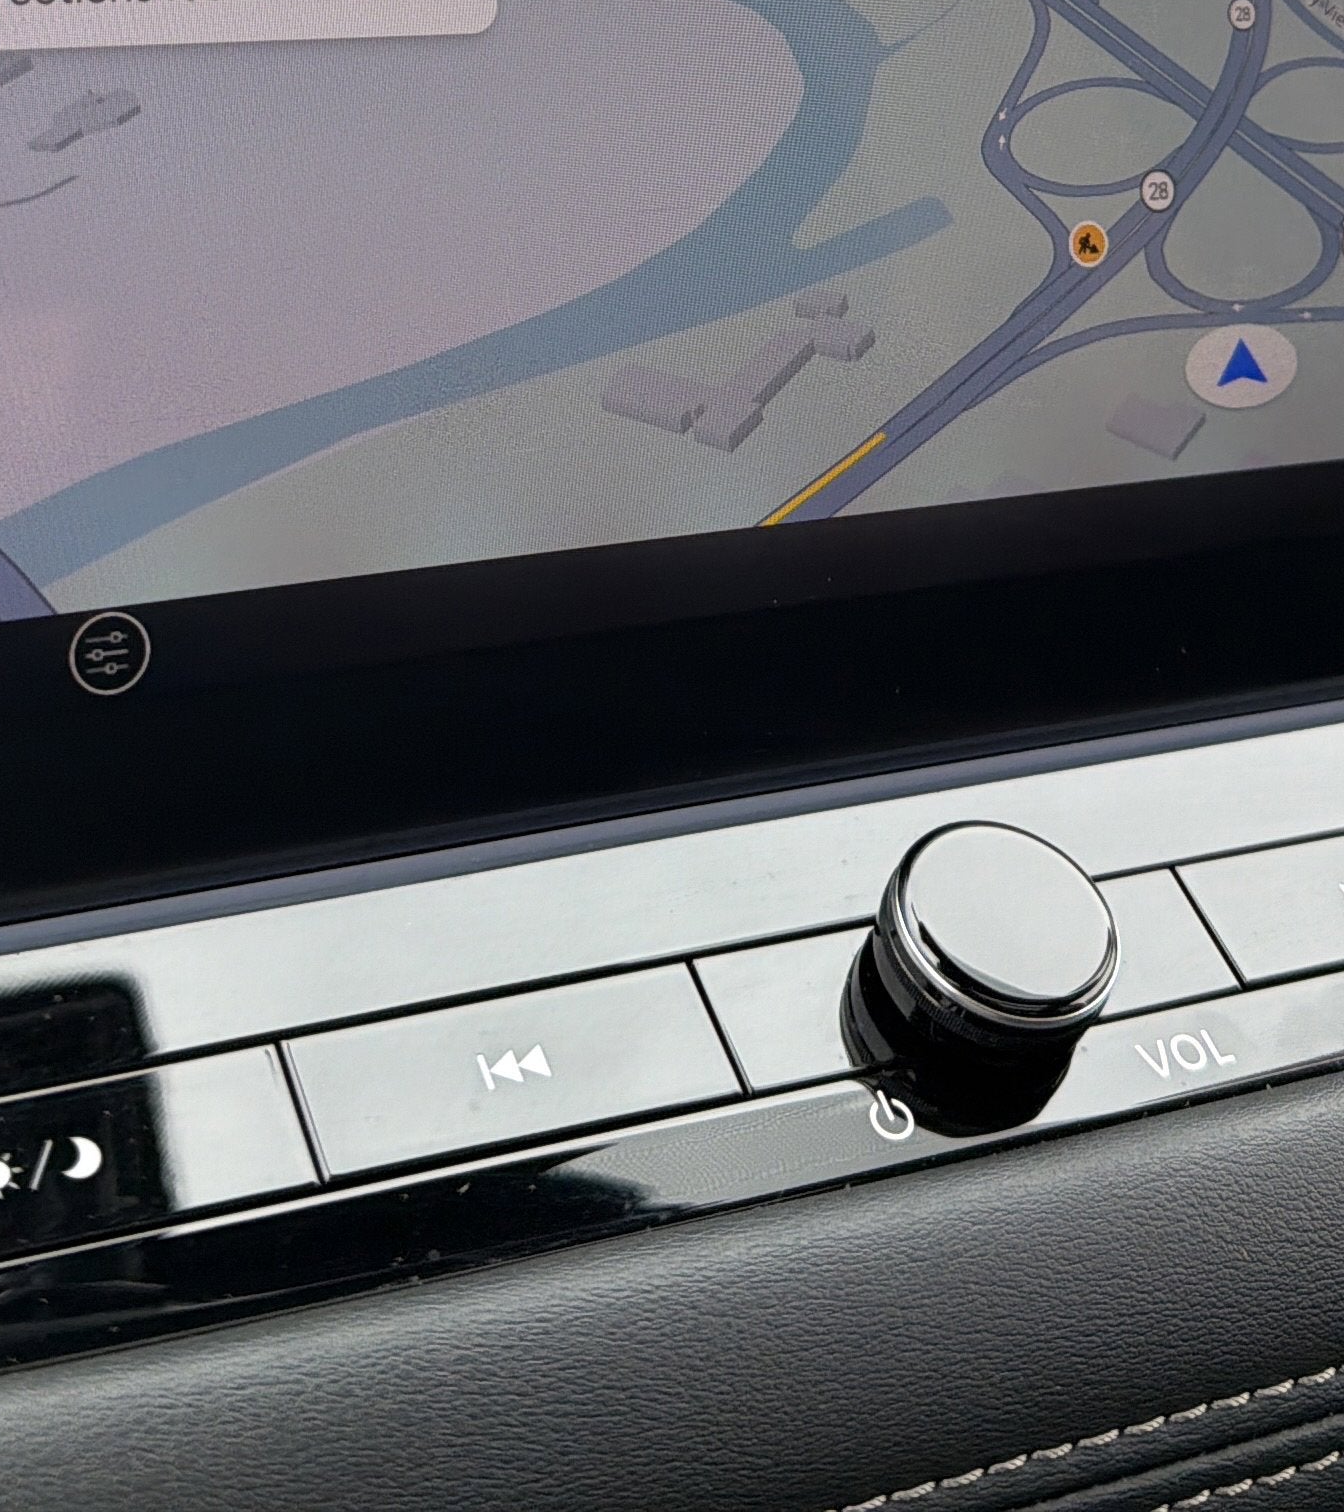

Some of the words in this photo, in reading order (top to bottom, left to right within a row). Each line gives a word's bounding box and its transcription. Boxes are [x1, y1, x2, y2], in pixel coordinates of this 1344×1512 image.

[1234, 5, 1252, 23] 28
[1148, 180, 1170, 201] 28
[1134, 1029, 1236, 1080] VOL
